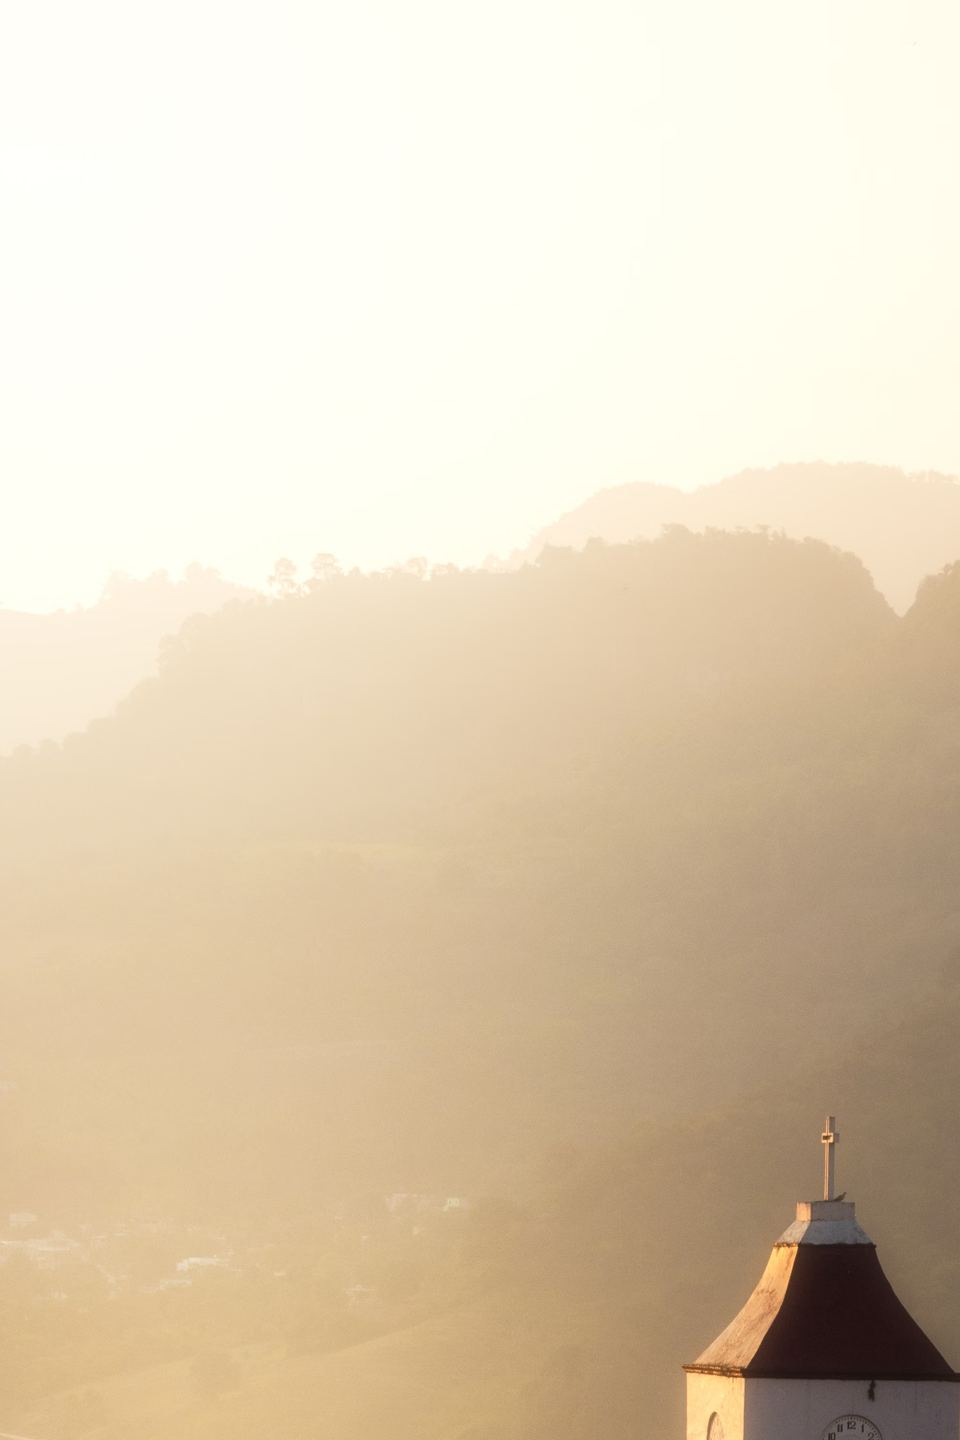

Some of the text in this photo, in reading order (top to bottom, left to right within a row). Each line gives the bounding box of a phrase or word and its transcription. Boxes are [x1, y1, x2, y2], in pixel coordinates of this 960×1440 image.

[837, 1424, 843, 1432] 11
[847, 1421, 856, 1430] 12
[861, 1424, 865, 1432] 1
[828, 1432, 836, 1440] 10
[867, 1432, 874, 1440] 2
